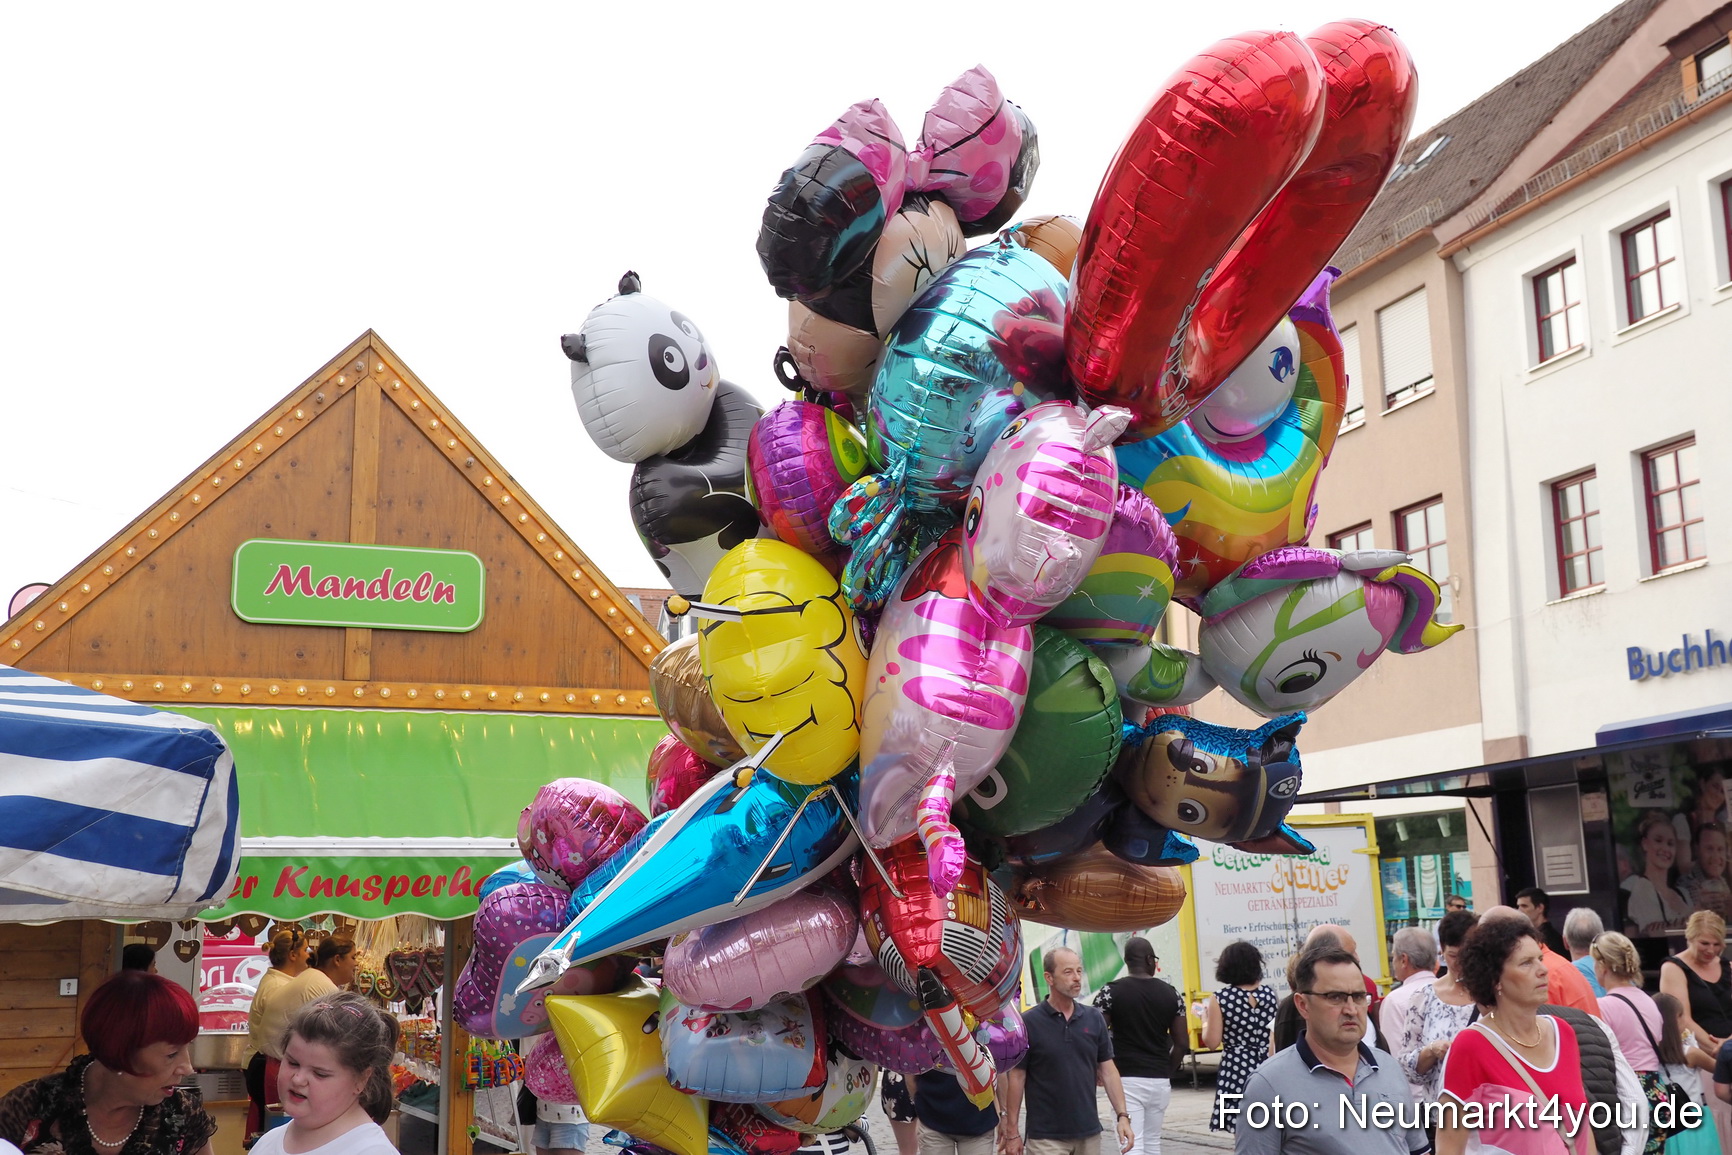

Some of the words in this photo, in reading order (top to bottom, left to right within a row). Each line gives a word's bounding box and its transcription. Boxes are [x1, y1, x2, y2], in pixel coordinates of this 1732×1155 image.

[264, 564, 456, 604] Mandeln
[1626, 628, 1732, 681] Buchh
[1223, 923, 1242, 934] Biere
